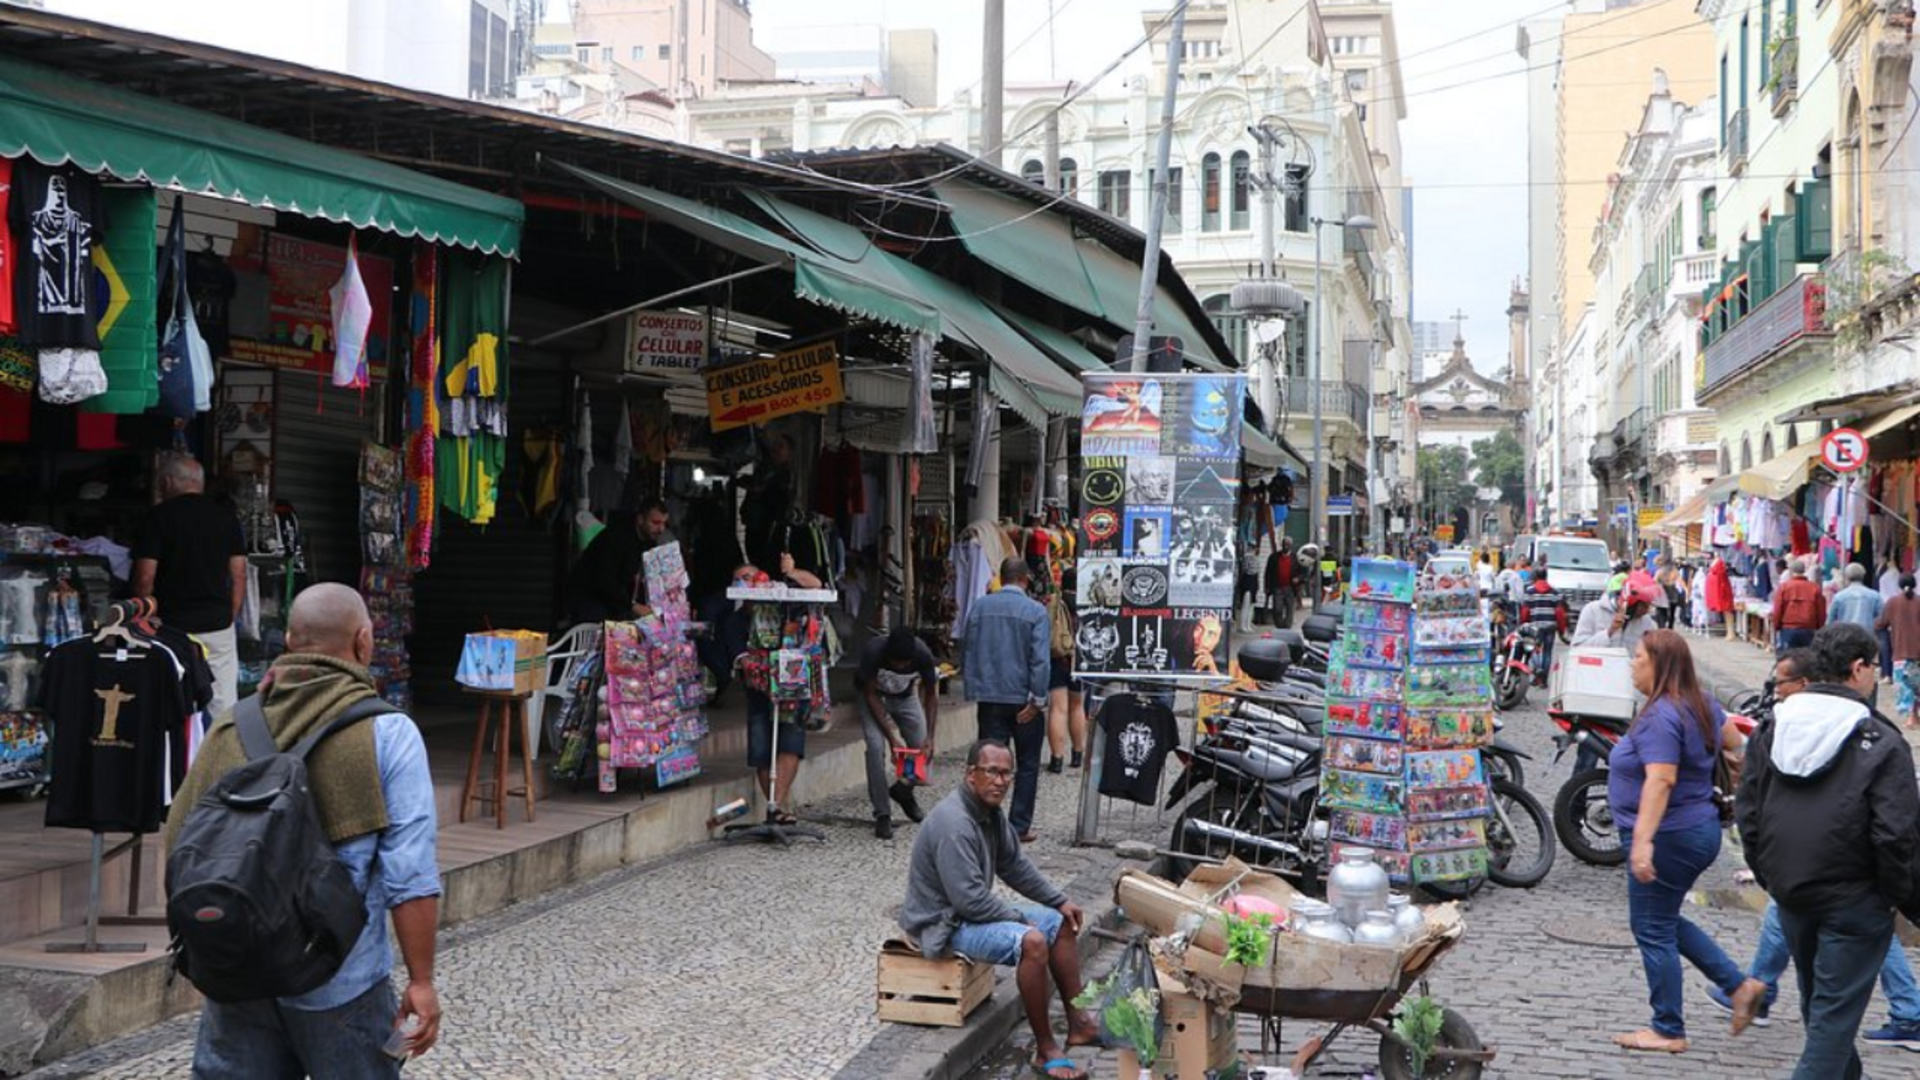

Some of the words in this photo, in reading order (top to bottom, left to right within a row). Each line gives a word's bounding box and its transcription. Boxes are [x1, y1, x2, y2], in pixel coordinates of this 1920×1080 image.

[638, 315, 704, 332] CONSERTOS
[638, 336, 703, 355] CELULAR
[637, 354, 644, 366] E
[650, 355, 700, 369] TABLET
[706, 362, 771, 393] CONSERTO
[779, 346, 834, 375] CELULAR
[721, 393, 731, 407] E
[803, 387, 832, 402] 450
[1837, 439, 1851, 462] E
[1174, 608, 1232, 622] LEGEND
